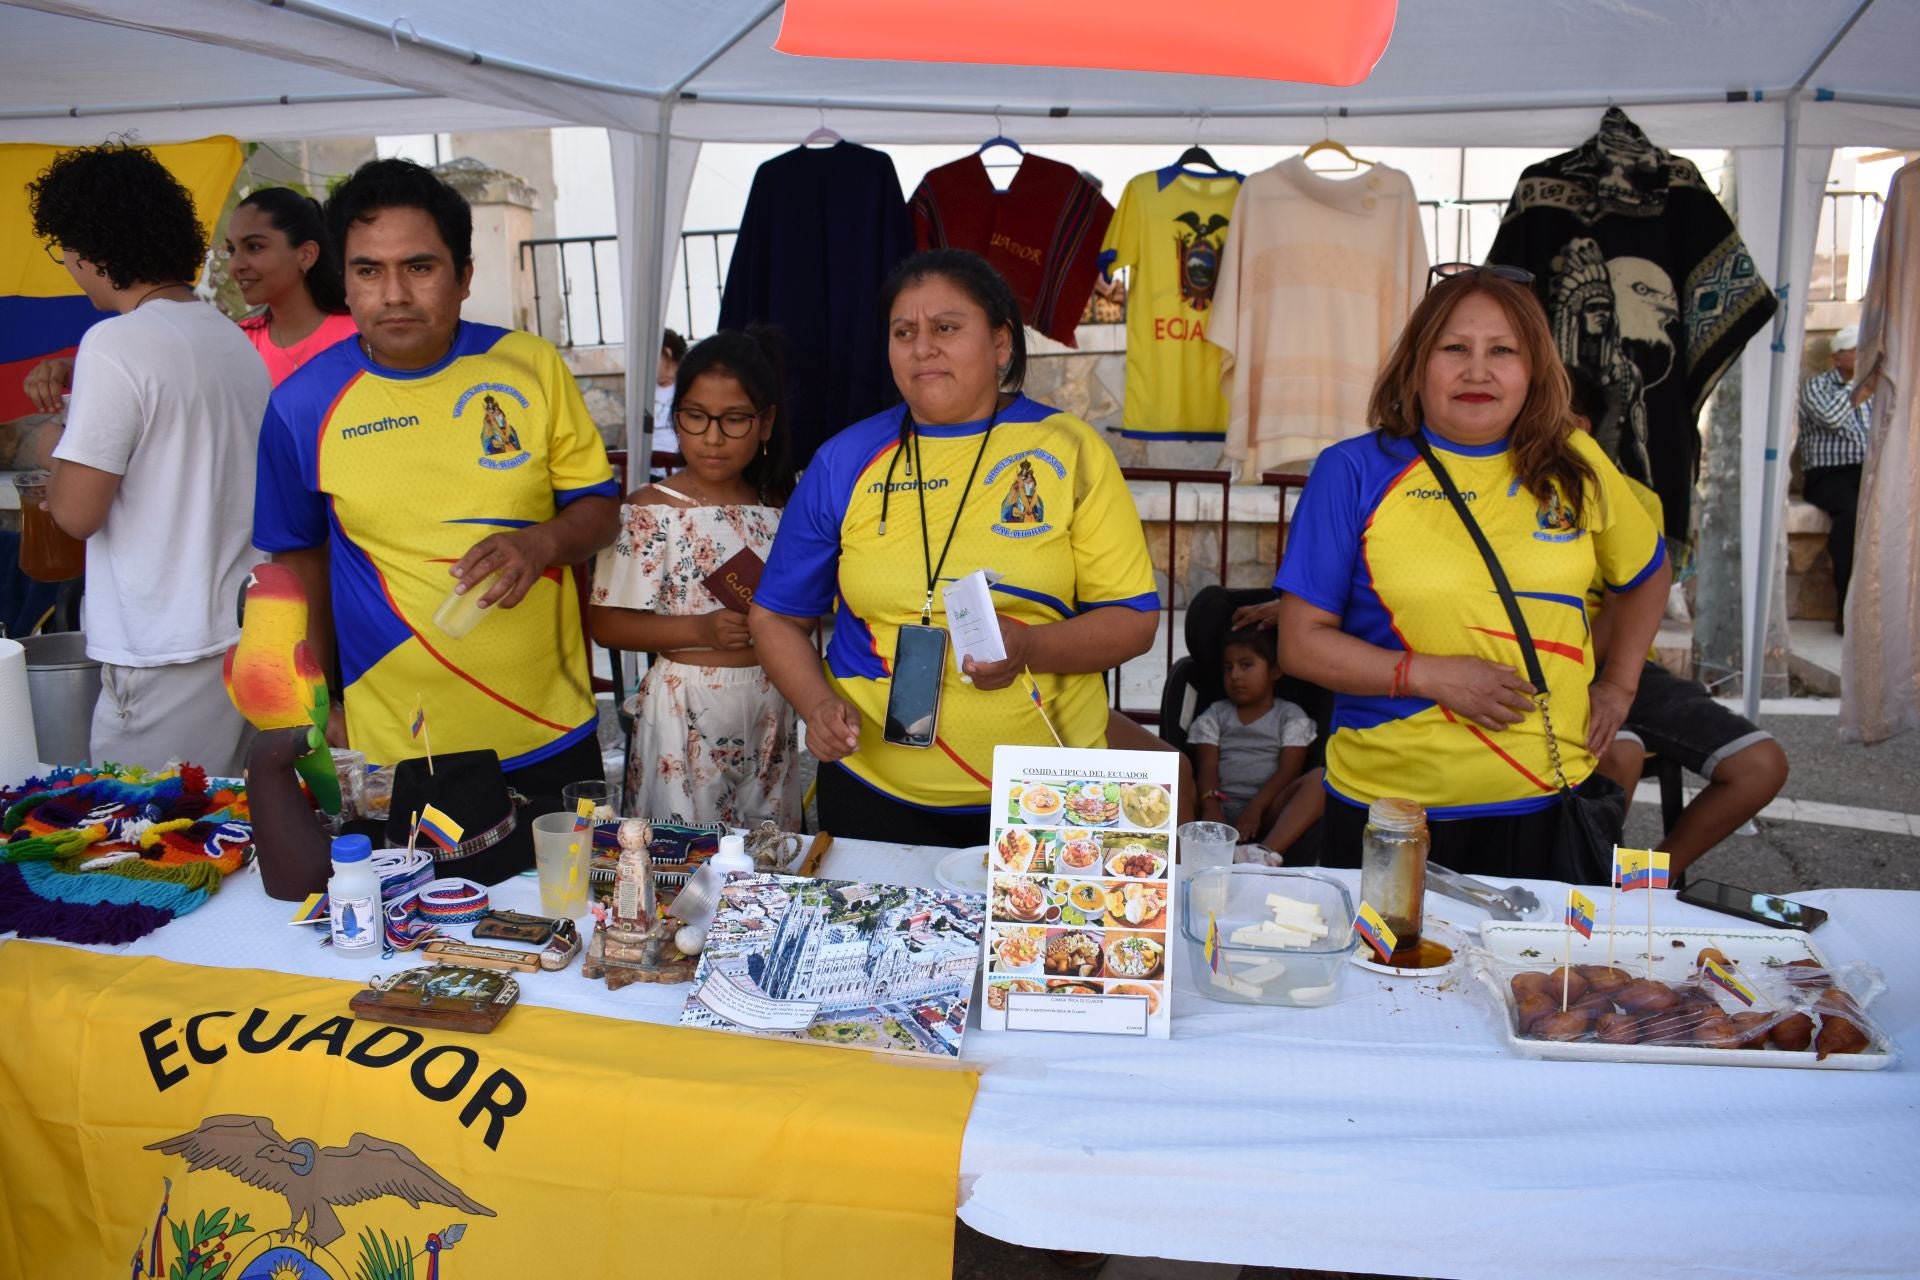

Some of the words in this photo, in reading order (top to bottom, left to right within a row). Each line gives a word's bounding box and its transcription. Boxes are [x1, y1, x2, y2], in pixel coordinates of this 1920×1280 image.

[342, 415, 420, 440] marathon
[1406, 488, 1477, 502] maraton
[1022, 767, 1057, 776] COMIDA
[1060, 768, 1088, 777] TIPICA
[1089, 770, 1105, 778] DEL
[1107, 771, 1149, 780] ECUADOR
[139, 1007, 528, 1152] ECUADOR
